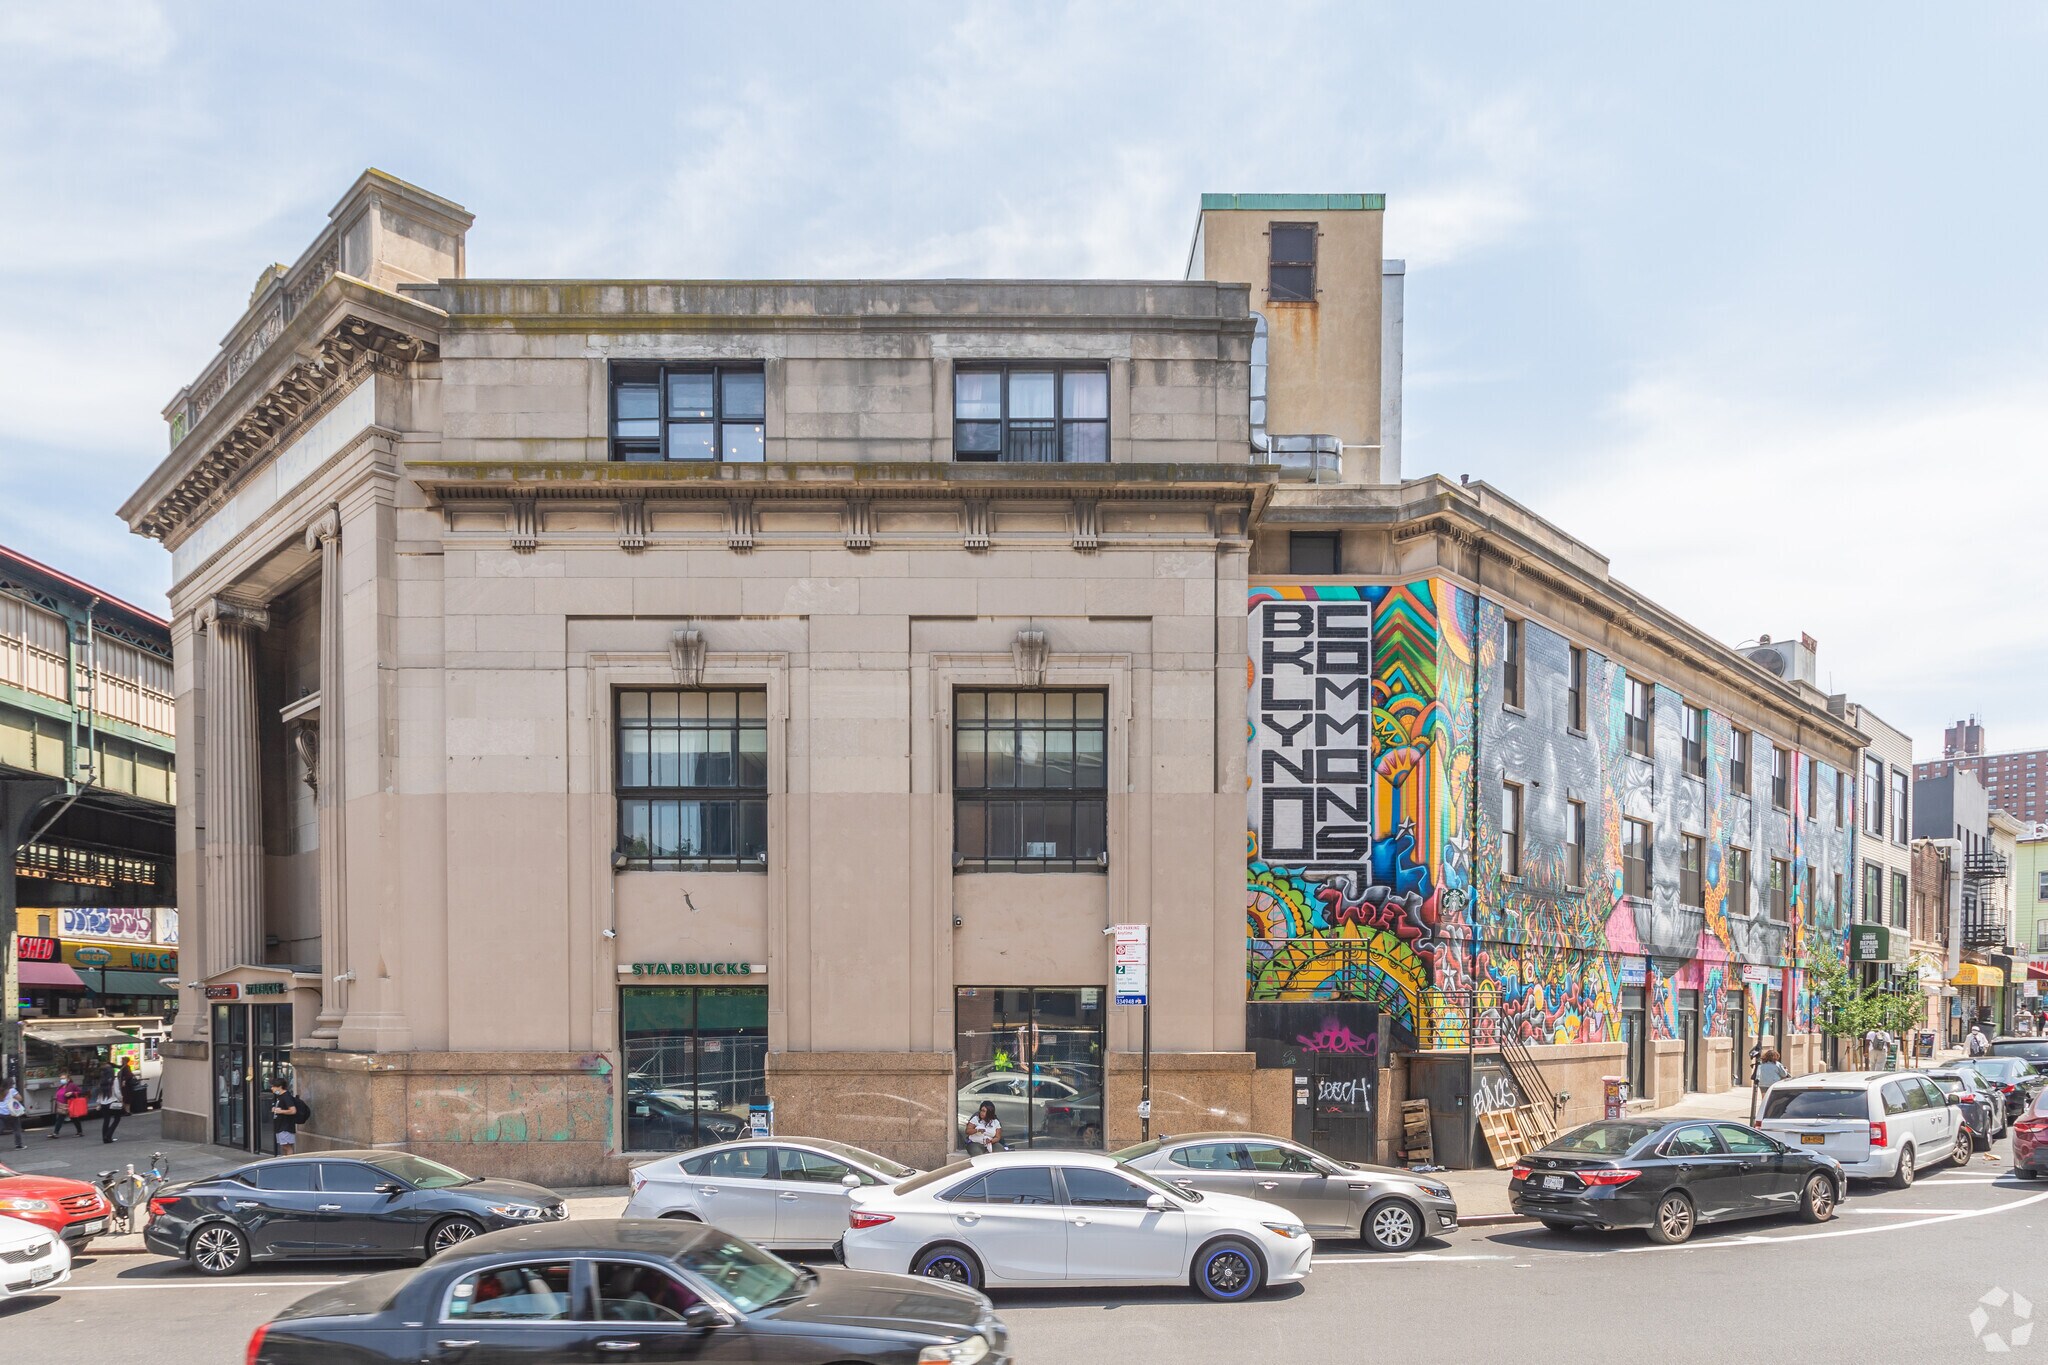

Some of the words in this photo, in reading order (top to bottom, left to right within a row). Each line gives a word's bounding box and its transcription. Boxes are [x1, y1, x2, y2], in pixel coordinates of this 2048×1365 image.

[1315, 605, 1368, 860] COMMONS
[17, 937, 54, 960] SHED
[632, 962, 751, 976] STARBUCKS
